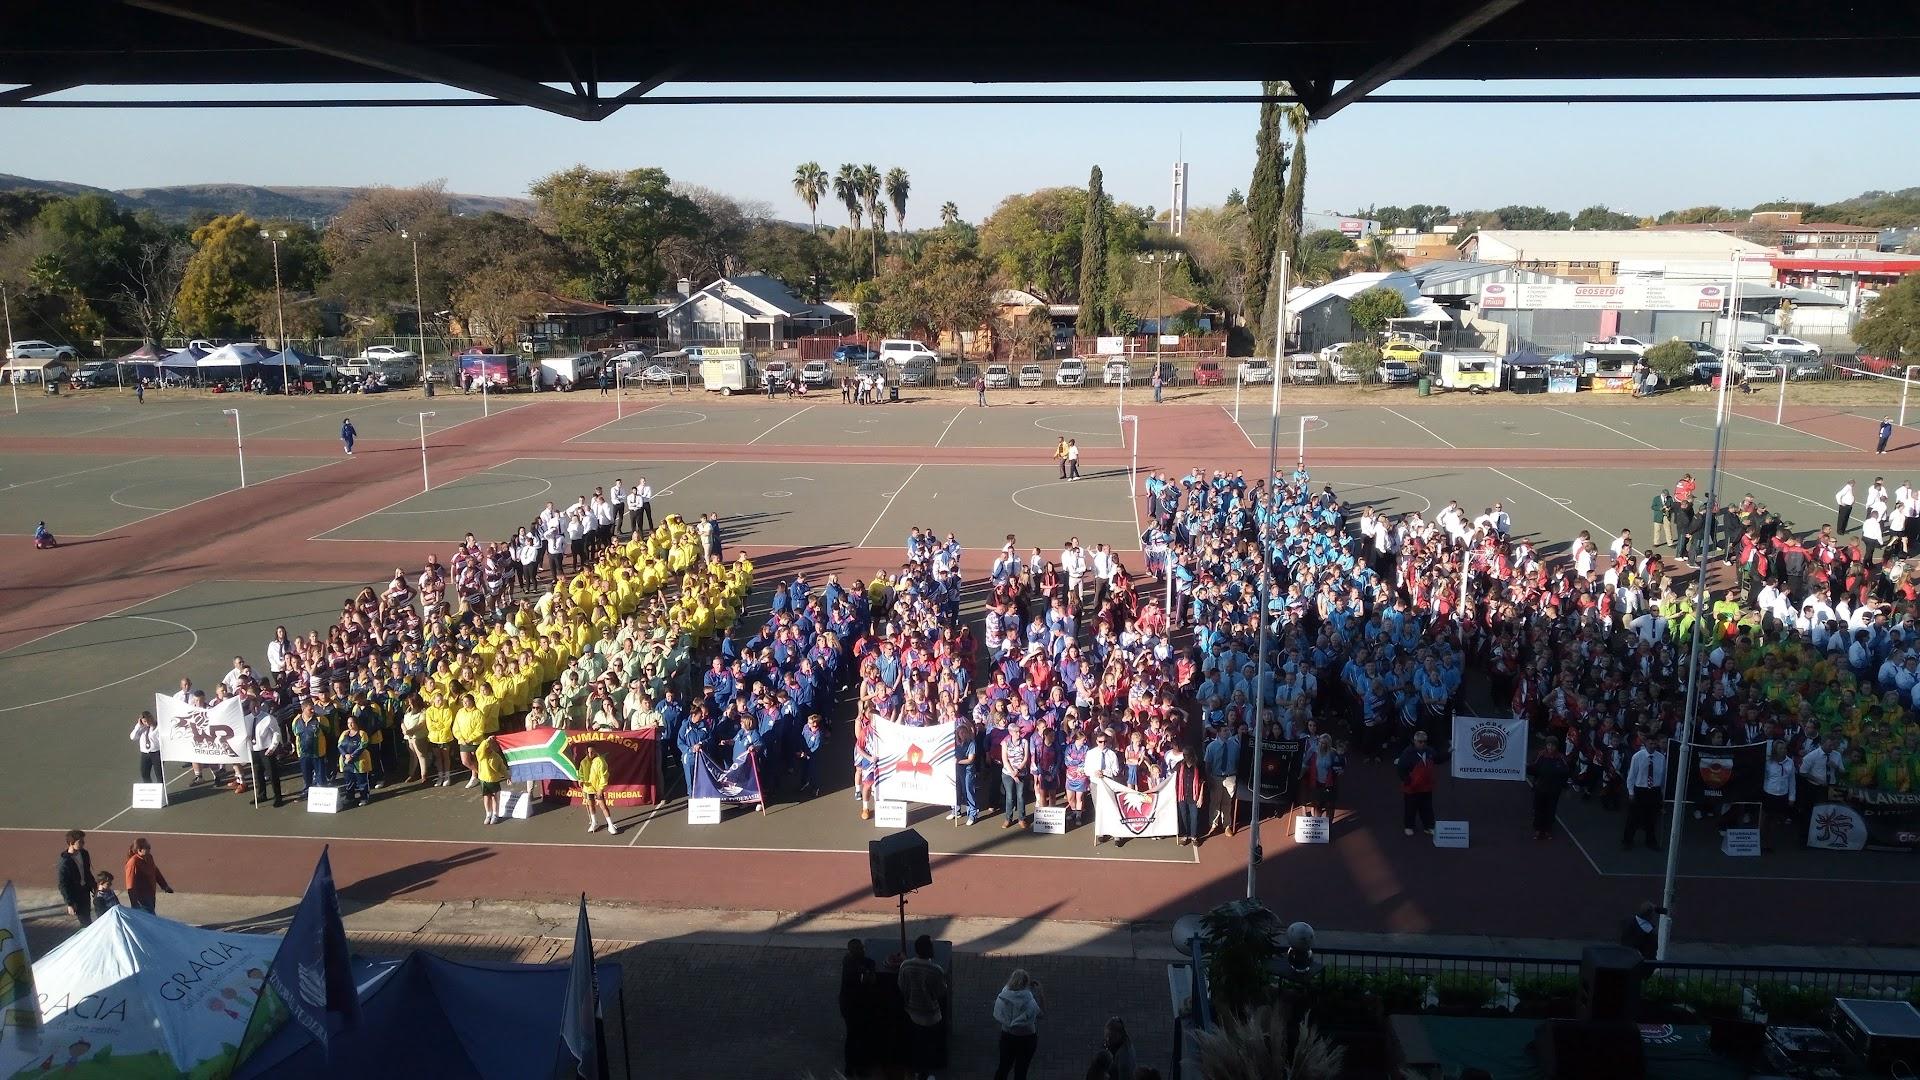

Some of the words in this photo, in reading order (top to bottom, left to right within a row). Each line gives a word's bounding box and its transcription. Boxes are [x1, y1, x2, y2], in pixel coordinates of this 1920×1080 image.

[566, 732, 640, 752] PUMALANGA
[608, 791, 642, 800] RINGBAL
[160, 942, 242, 1001] GRACIA
